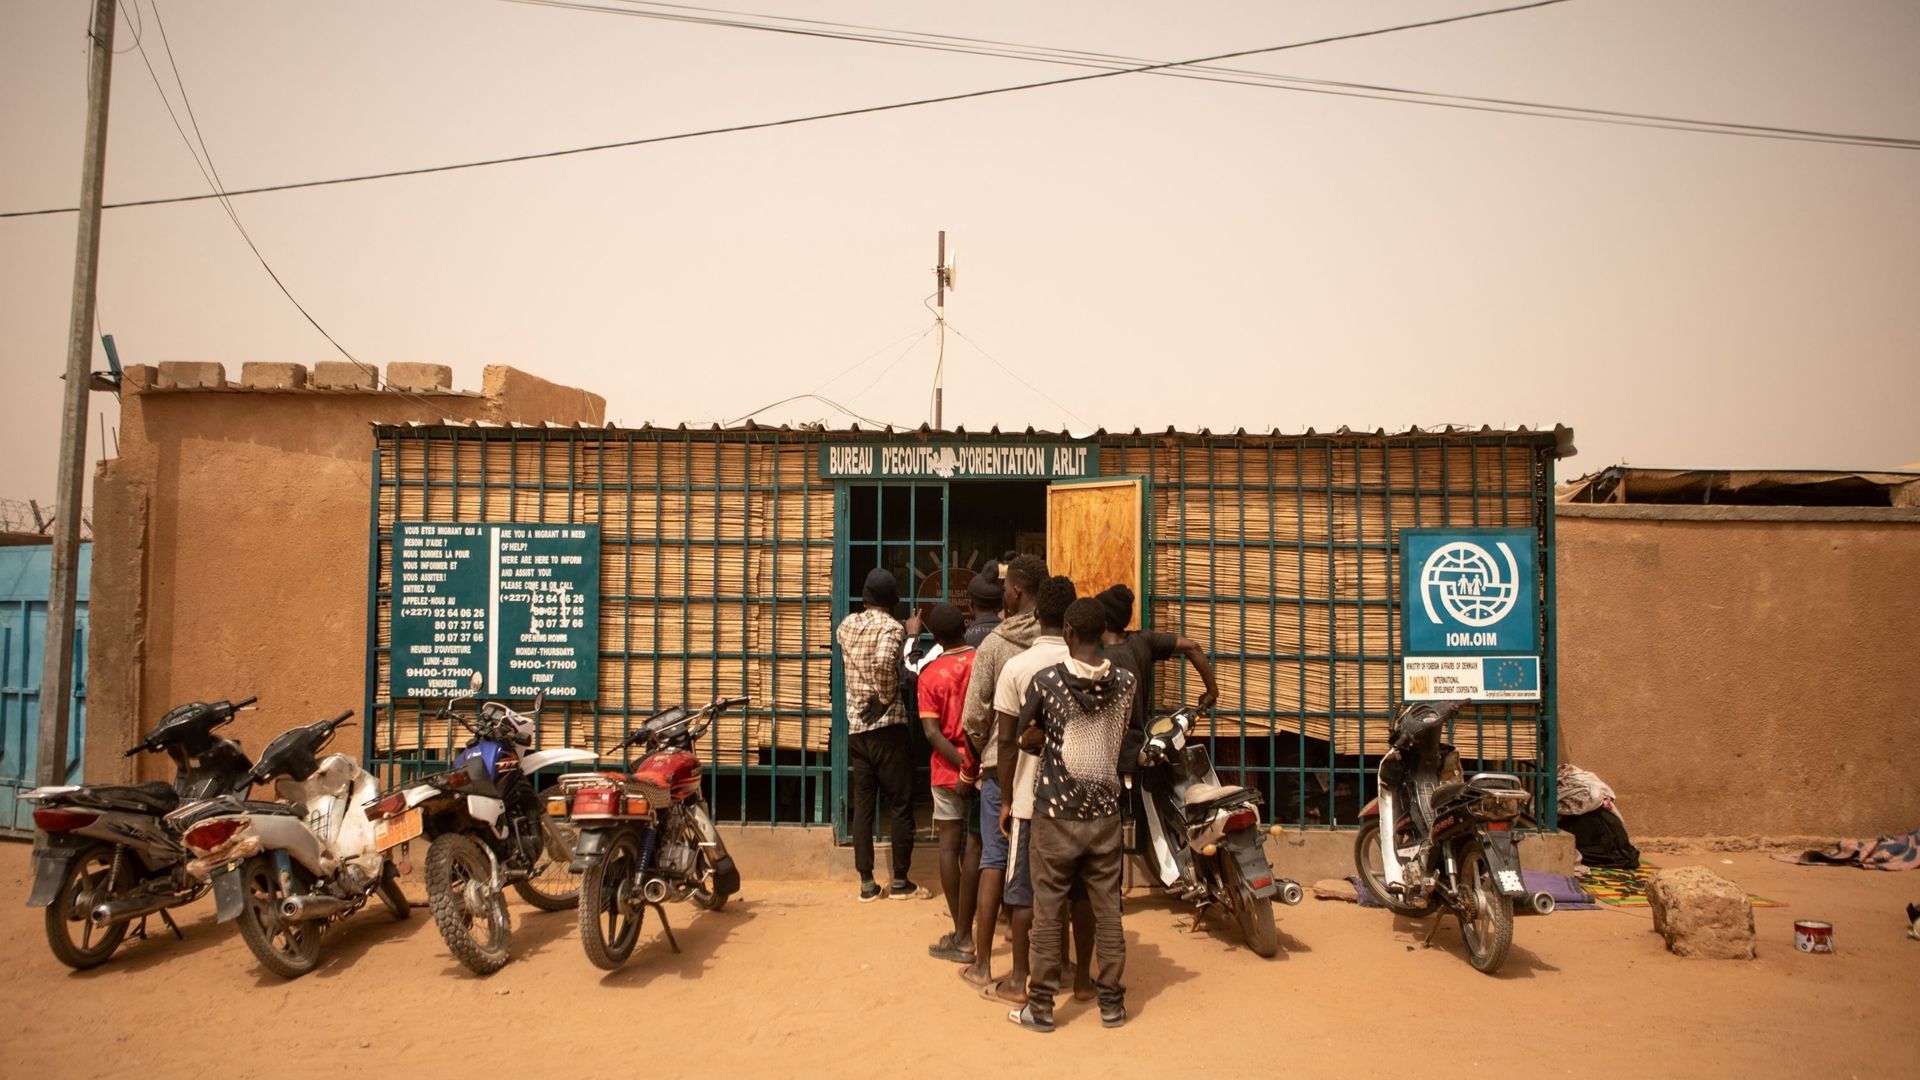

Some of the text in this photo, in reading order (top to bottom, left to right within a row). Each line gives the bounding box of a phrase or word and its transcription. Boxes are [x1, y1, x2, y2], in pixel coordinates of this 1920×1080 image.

[829, 447, 873, 475] BUREAU
[882, 447, 932, 475] D'ECOUTE
[959, 447, 1045, 475] D'ORIENTATION
[1052, 447, 1087, 475] ARLIT
[404, 526, 483, 535] VOUS ETES MIGRANT QUI A
[500, 530, 586, 538] ARE YOU A MIGRANT IN NEED
[404, 539, 423, 547] BESOIN
[509, 543, 528, 551] HELP?
[403, 550, 470, 558] NOUS SOMMES LA POUR
[521, 556, 532, 564] ARE
[534, 556, 549, 564] HERE
[551, 556, 558, 564] TO
[560, 556, 582, 564] INFORM
[403, 562, 457, 570] VOUS INFORMER ET
[402, 573, 418, 581] VOUS
[501, 569, 513, 577] AND
[515, 569, 535, 577] ASSIST
[403, 585, 436, 593] ENTREZ OU
[500, 582, 522, 590] PLEASE
[524, 582, 539, 590] COME
[549, 582, 557, 590] OR
[560, 582, 574, 590] CALL
[402, 597, 456, 605] APPELEZ-NOUS AU
[500, 594, 531, 603] (+227)
[546, 594, 557, 603] 64
[573, 594, 584, 603] 26
[401, 609, 485, 617] (+227) 92 64 06 26
[572, 607, 584, 615] 65
[434, 621, 484, 630] 80 07 37 65
[546, 619, 557, 628] 07
[572, 619, 583, 628] 66
[434, 633, 484, 642] 80 07 37 66
[520, 634, 547, 642] OPENING
[1446, 633, 1497, 646] IOM.OIM
[410, 645, 471, 654] HEURES D'OUVERTURE
[423, 657, 459, 665] LUNDI-JEUDI
[509, 660, 577, 669] 9H00-17H00
[406, 668, 473, 676] 9H00-17H00
[532, 674, 554, 682] FRIDAY
[428, 679, 457, 687] VENDREDI
[407, 688, 474, 696] 9H00-14H00
